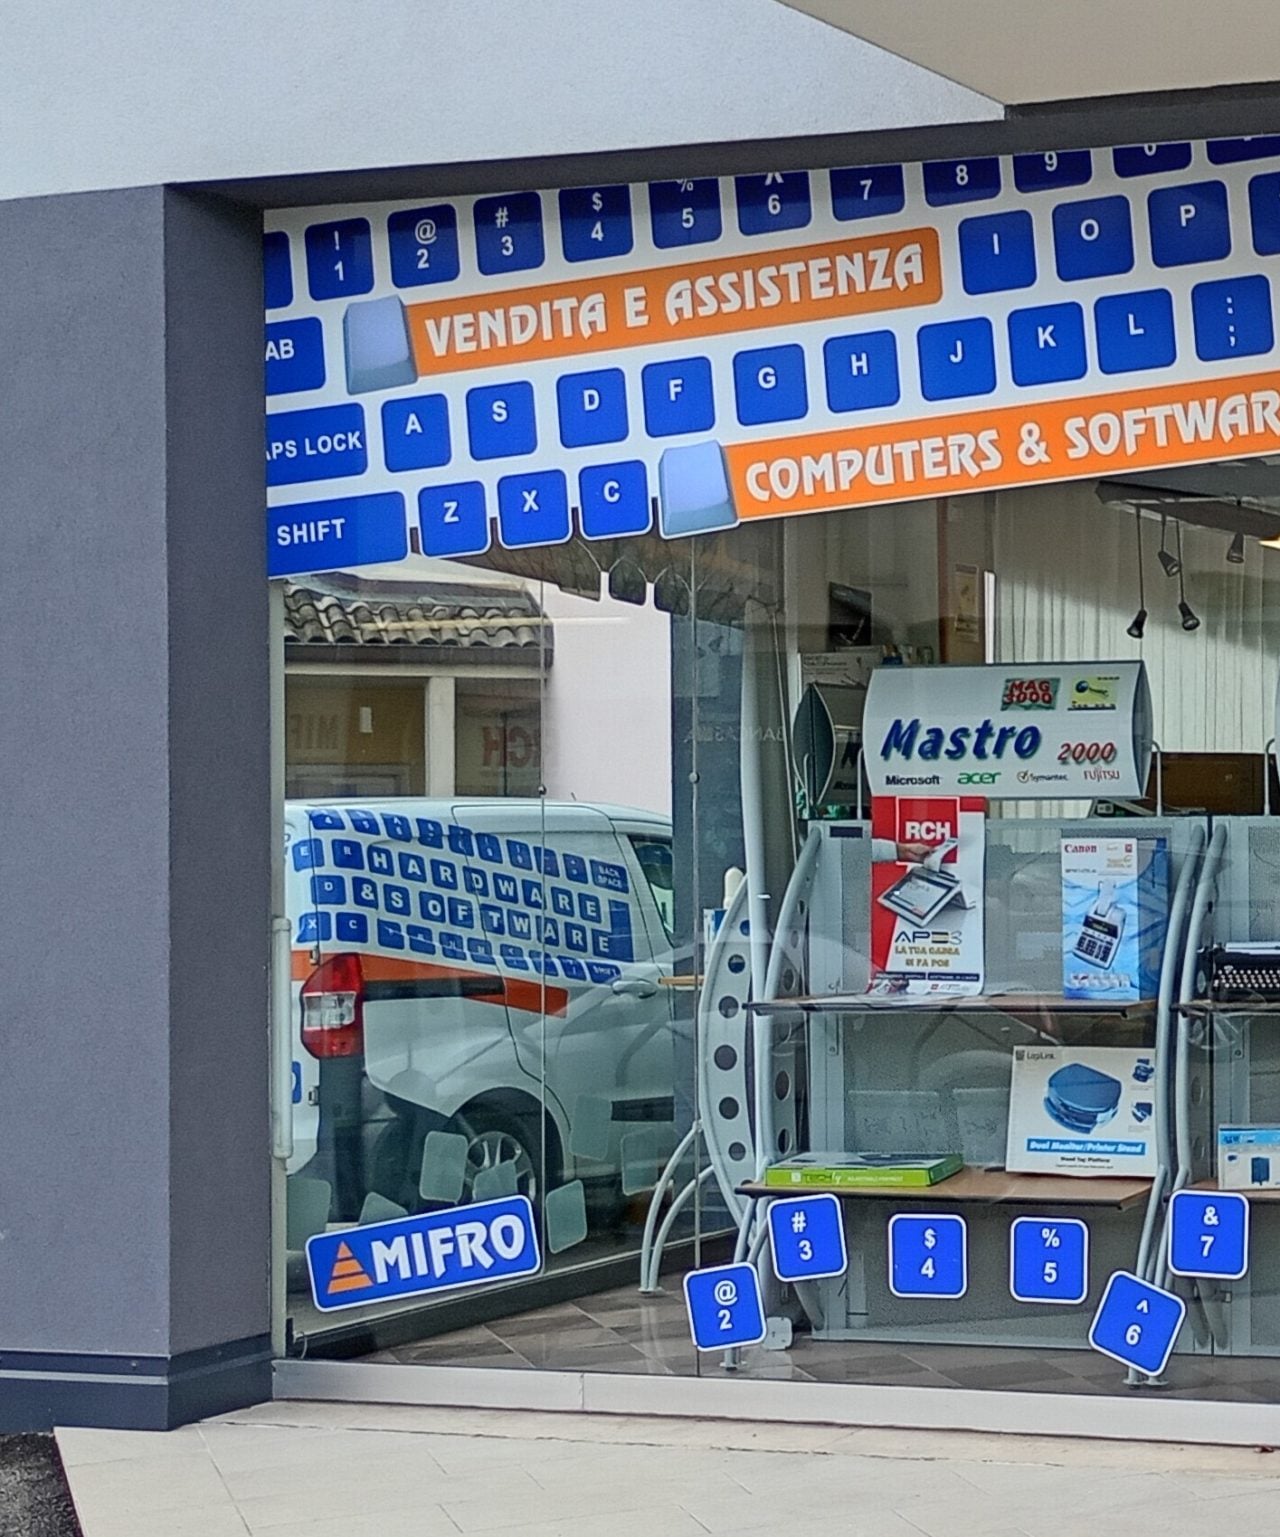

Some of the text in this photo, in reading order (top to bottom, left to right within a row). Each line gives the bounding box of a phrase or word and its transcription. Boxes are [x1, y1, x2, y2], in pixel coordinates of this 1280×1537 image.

[1044, 152, 1058, 171] 9
[955, 165, 969, 186] 8
[860, 179, 872, 200] 7
[592, 192, 602, 212] $
[768, 194, 780, 215] 6
[495, 207, 509, 228] #
[682, 208, 694, 228] 5
[1180, 204, 1196, 227] P
[333, 230, 340, 250] !
[415, 219, 438, 245] @
[591, 222, 604, 242] 4
[1081, 219, 1100, 241] O
[502, 236, 513, 256] 3
[992, 233, 1000, 255] I
[416, 249, 430, 269] 2
[334, 261, 344, 281] 1
[425, 242, 925, 357] VENDITA E ASSISTENZA
[1129, 314, 1144, 336] L
[1038, 326, 1056, 348] K
[950, 341, 963, 363] J
[851, 354, 868, 376] H
[758, 368, 776, 389] G
[582, 389, 601, 411] D
[669, 379, 683, 401] F
[491, 402, 508, 423] S
[405, 413, 423, 435] A
[305, 431, 362, 456] LOCK
[746, 429, 1002, 502] COMPUTERS
[1018, 423, 1048, 465] &
[522, 491, 539, 513] X
[604, 481, 620, 502] C
[443, 502, 459, 523] Z
[277, 518, 346, 546] SHIFT
[1010, 681, 1051, 691] MAG
[881, 718, 1118, 765] Mastro 2000
[885, 775, 941, 786] Microsoft
[957, 772, 1001, 785] acer
[1084, 766, 1120, 782] FUJITSU
[905, 821, 951, 840] RCH
[1064, 844, 1097, 853] Canon
[373, 851, 598, 917] HARDWARE
[361, 884, 609, 952] & SOFTWARE
[792, 1211, 806, 1233] #
[1203, 1206, 1219, 1226] &
[924, 1227, 936, 1249] $
[1041, 1227, 1060, 1247] %
[1201, 1236, 1214, 1258] 7
[371, 1214, 526, 1284] MIFRO
[799, 1239, 812, 1261] 3
[921, 1257, 935, 1279] 4
[1043, 1262, 1057, 1283] 5
[714, 1280, 738, 1306] @
[719, 1309, 733, 1330] 2
[1126, 1324, 1142, 1347] 6
